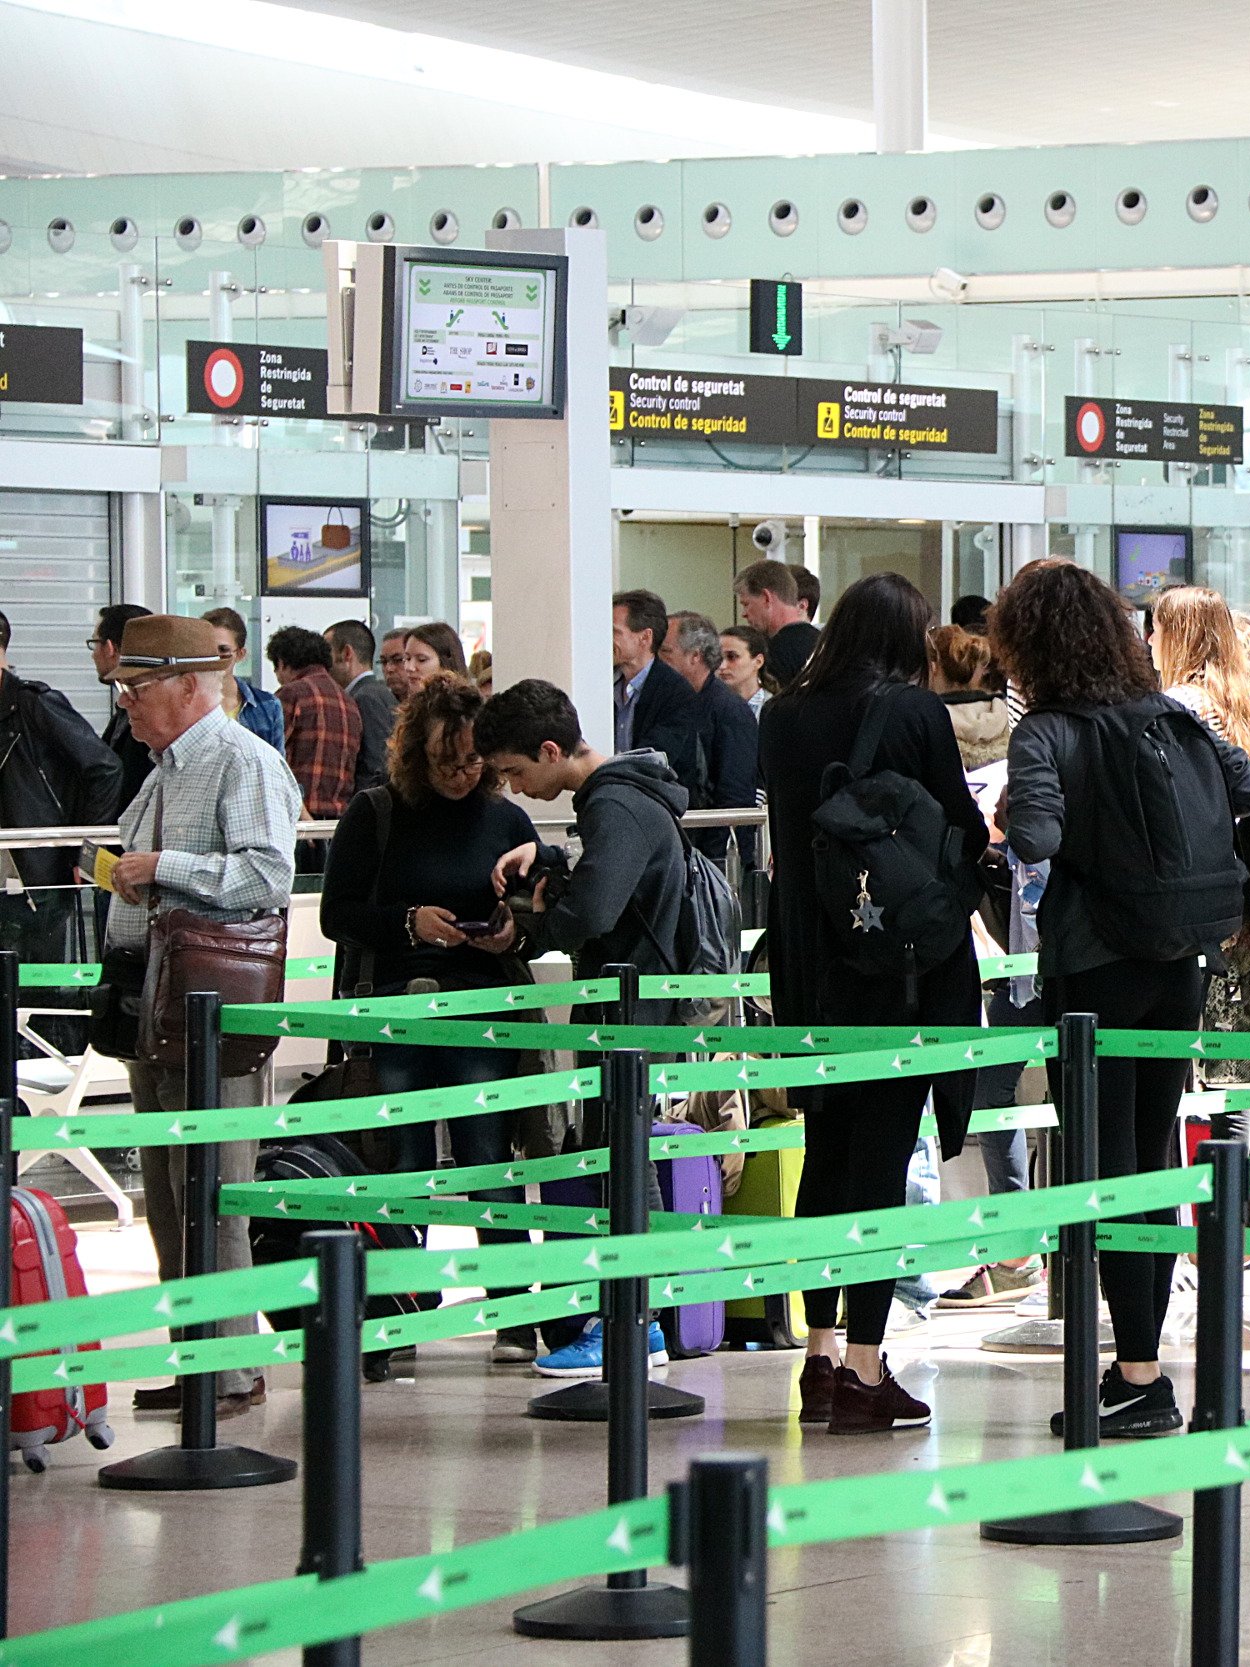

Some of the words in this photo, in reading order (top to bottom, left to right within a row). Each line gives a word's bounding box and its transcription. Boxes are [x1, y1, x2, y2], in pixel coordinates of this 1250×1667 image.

[260, 350, 282, 364] Zona
[260, 366, 312, 382] Restringida
[260, 381, 272, 392] de
[630, 373, 670, 391] Control
[674, 376, 688, 392] de
[692, 380, 744, 397] seguretat
[630, 393, 666, 411] Security
[669, 397, 700, 410] control
[844, 386, 881, 403] Control
[884, 389, 896, 404] de
[900, 393, 946, 408] seguretat
[260, 396, 306, 411] Seguretat
[1116, 404, 1132, 415] Zona
[845, 405, 876, 422] Security
[879, 409, 905, 422] control
[1164, 413, 1184, 425] Security
[1200, 408, 1215, 420] Zona
[629, 412, 670, 429] Control
[674, 414, 687, 429] de
[691, 417, 746, 434] seguridad
[1116, 417, 1152, 430] Restringida
[1200, 420, 1234, 432] Restringida
[844, 423, 880, 439] Control
[884, 425, 895, 439] de
[899, 428, 947, 444] seguridad
[1116, 430, 1125, 440] de
[1163, 426, 1188, 437] Restricted
[1116, 442, 1148, 454] Seguretat
[1163, 440, 1176, 450] Area
[1200, 444, 1230, 456] Seguridad
